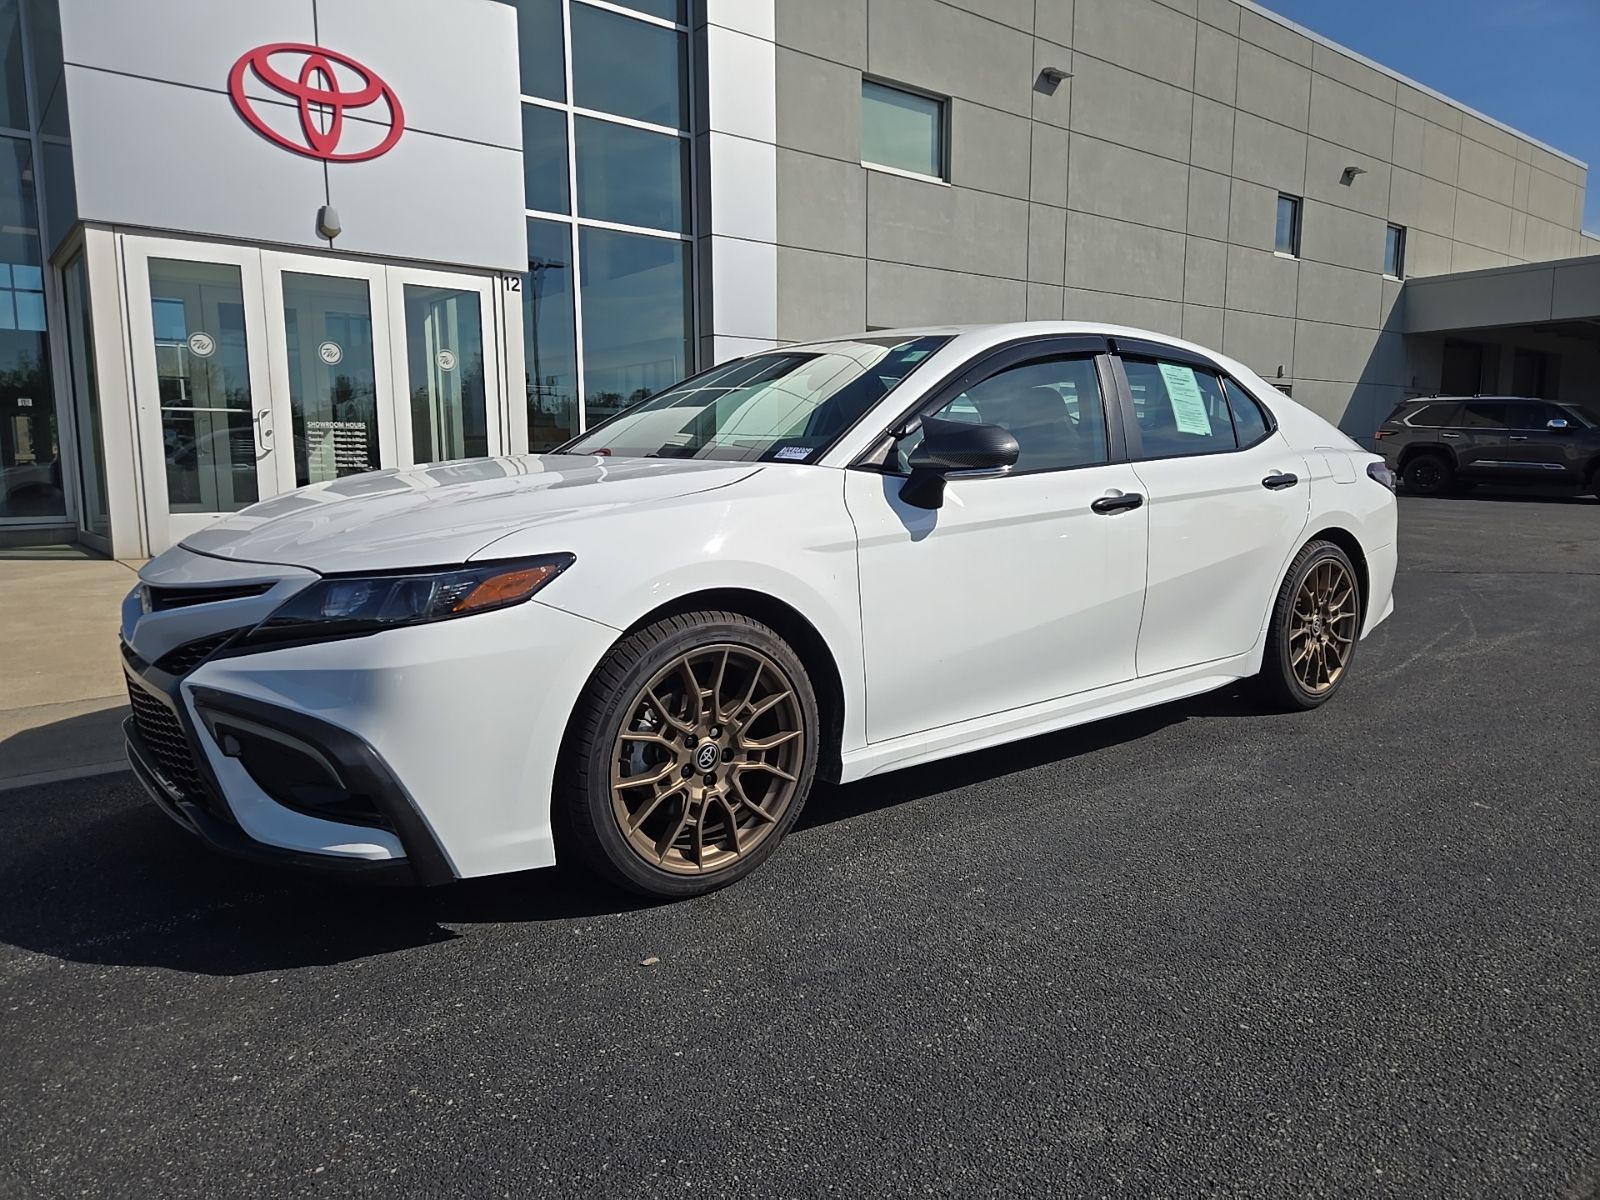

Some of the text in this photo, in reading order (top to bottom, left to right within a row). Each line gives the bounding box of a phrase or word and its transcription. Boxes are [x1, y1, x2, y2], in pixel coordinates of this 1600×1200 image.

[504, 276, 520, 292] 12
[307, 421, 366, 430] SHOWROOM HOURS
